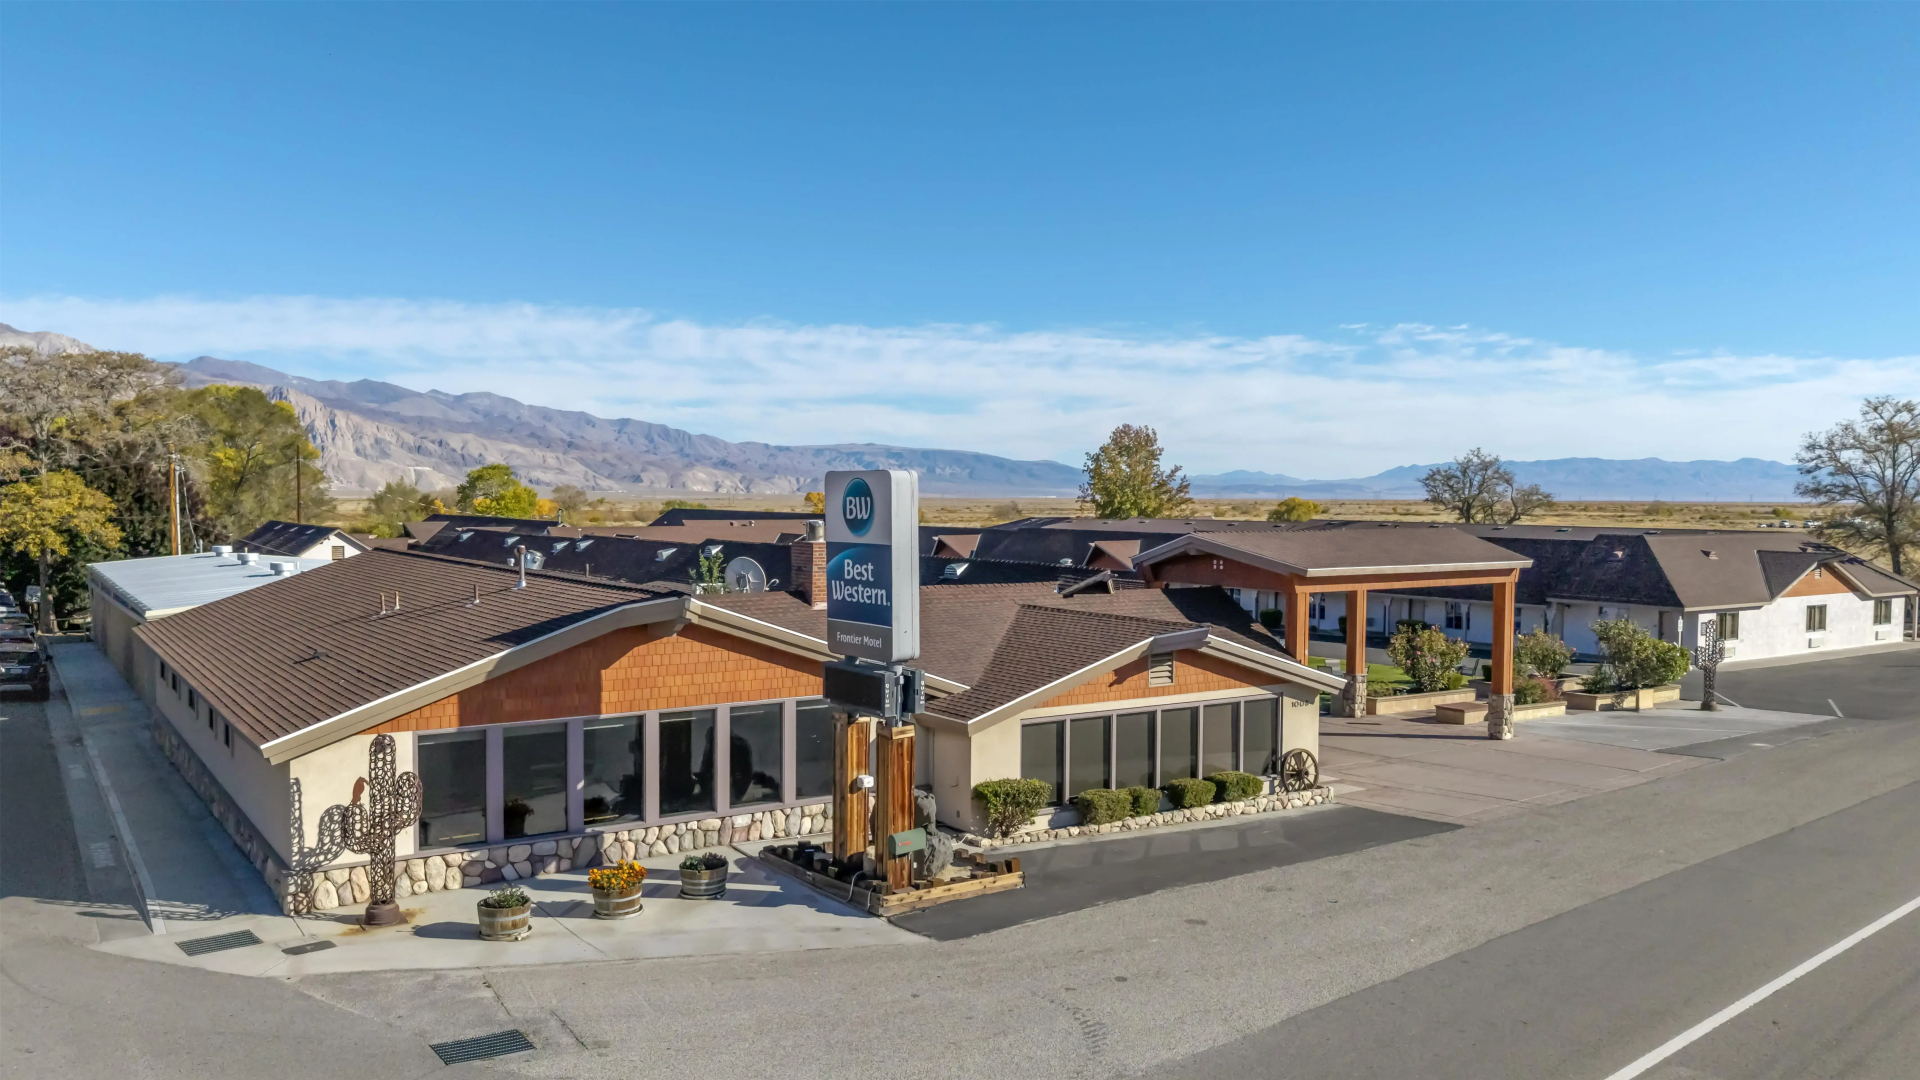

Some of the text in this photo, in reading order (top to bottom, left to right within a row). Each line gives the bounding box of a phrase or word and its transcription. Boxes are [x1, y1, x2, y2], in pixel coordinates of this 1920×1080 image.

[846, 497, 871, 520] BW
[844, 559, 874, 581] Best
[836, 631, 882, 648] Frontier Motel
